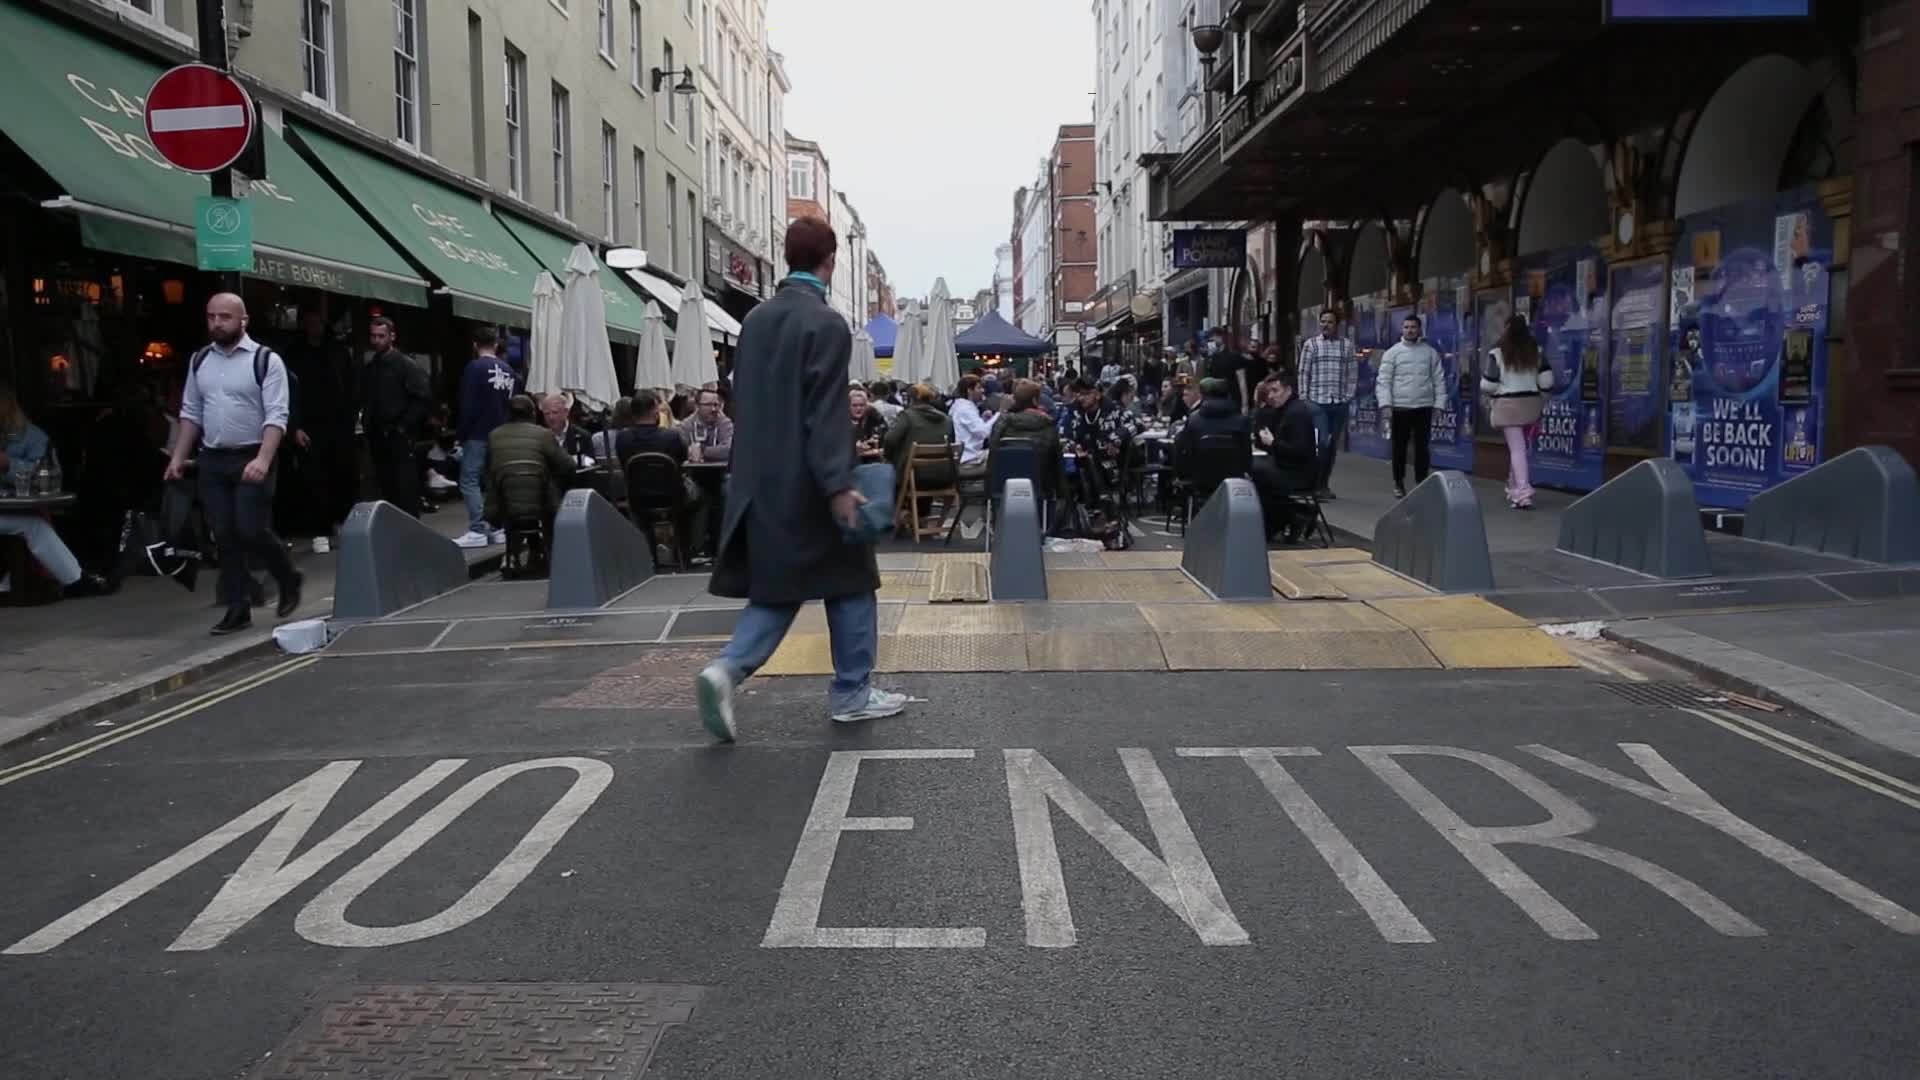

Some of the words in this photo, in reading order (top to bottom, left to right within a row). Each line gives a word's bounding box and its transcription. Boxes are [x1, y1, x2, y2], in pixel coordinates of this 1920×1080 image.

[66, 73, 145, 120] CA
[411, 203, 473, 237] CAFE
[428, 236, 519, 275] BOHEME
[291, 263, 345, 289] BOHEME
[1712, 398, 1763, 421] WE'LL
[1548, 417, 1577, 436] BACK
[1703, 421, 1721, 443] BE
[1724, 422, 1772, 447] BACK
[1537, 435, 1574, 455] SOON!
[1705, 445, 1766, 472] SOON!
[3, 756, 614, 955] NO
[760, 742, 1920, 949] ENTRY
